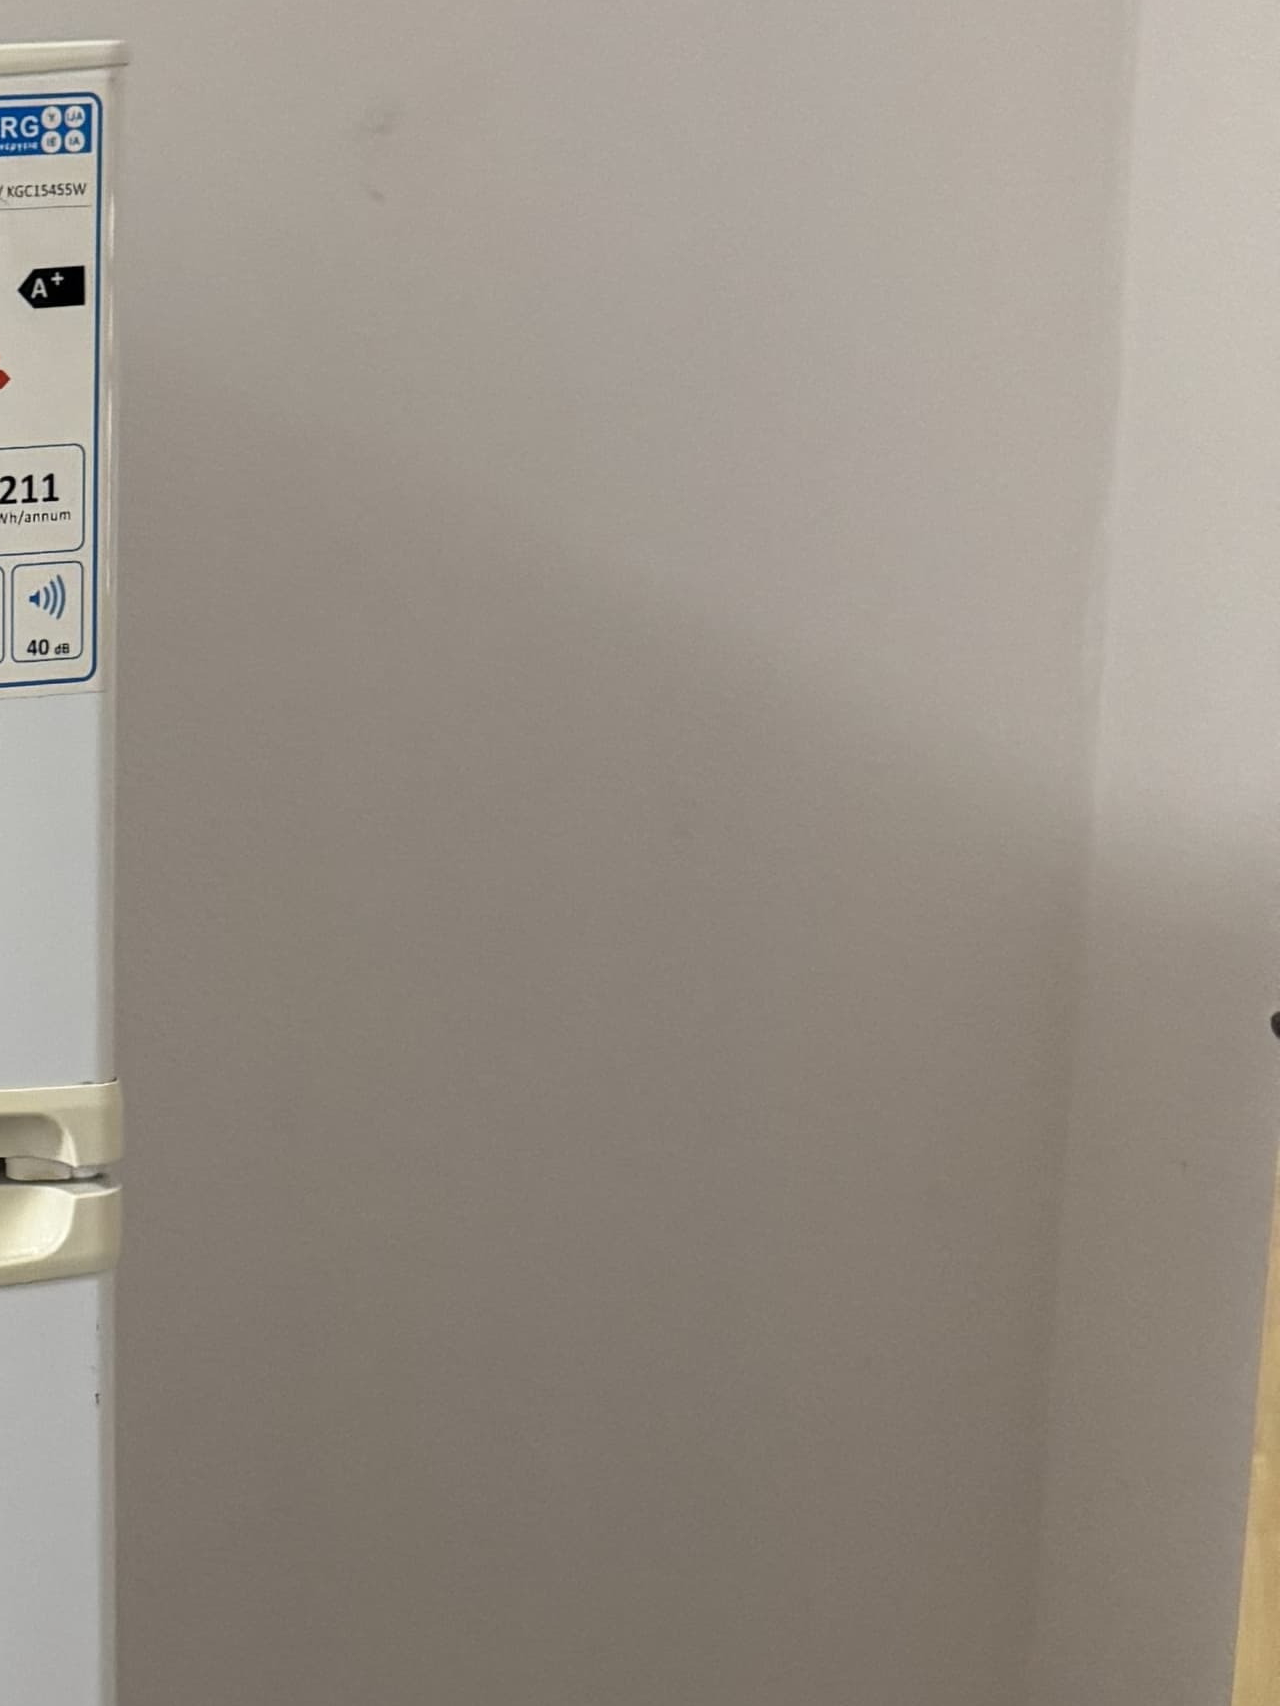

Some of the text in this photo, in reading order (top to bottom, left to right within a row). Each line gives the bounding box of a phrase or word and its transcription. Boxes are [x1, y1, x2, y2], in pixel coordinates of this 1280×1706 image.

[7, 182, 88, 198] KGC15455W
[30, 271, 65, 300] A+
[26, 639, 70, 656] 40 dB
